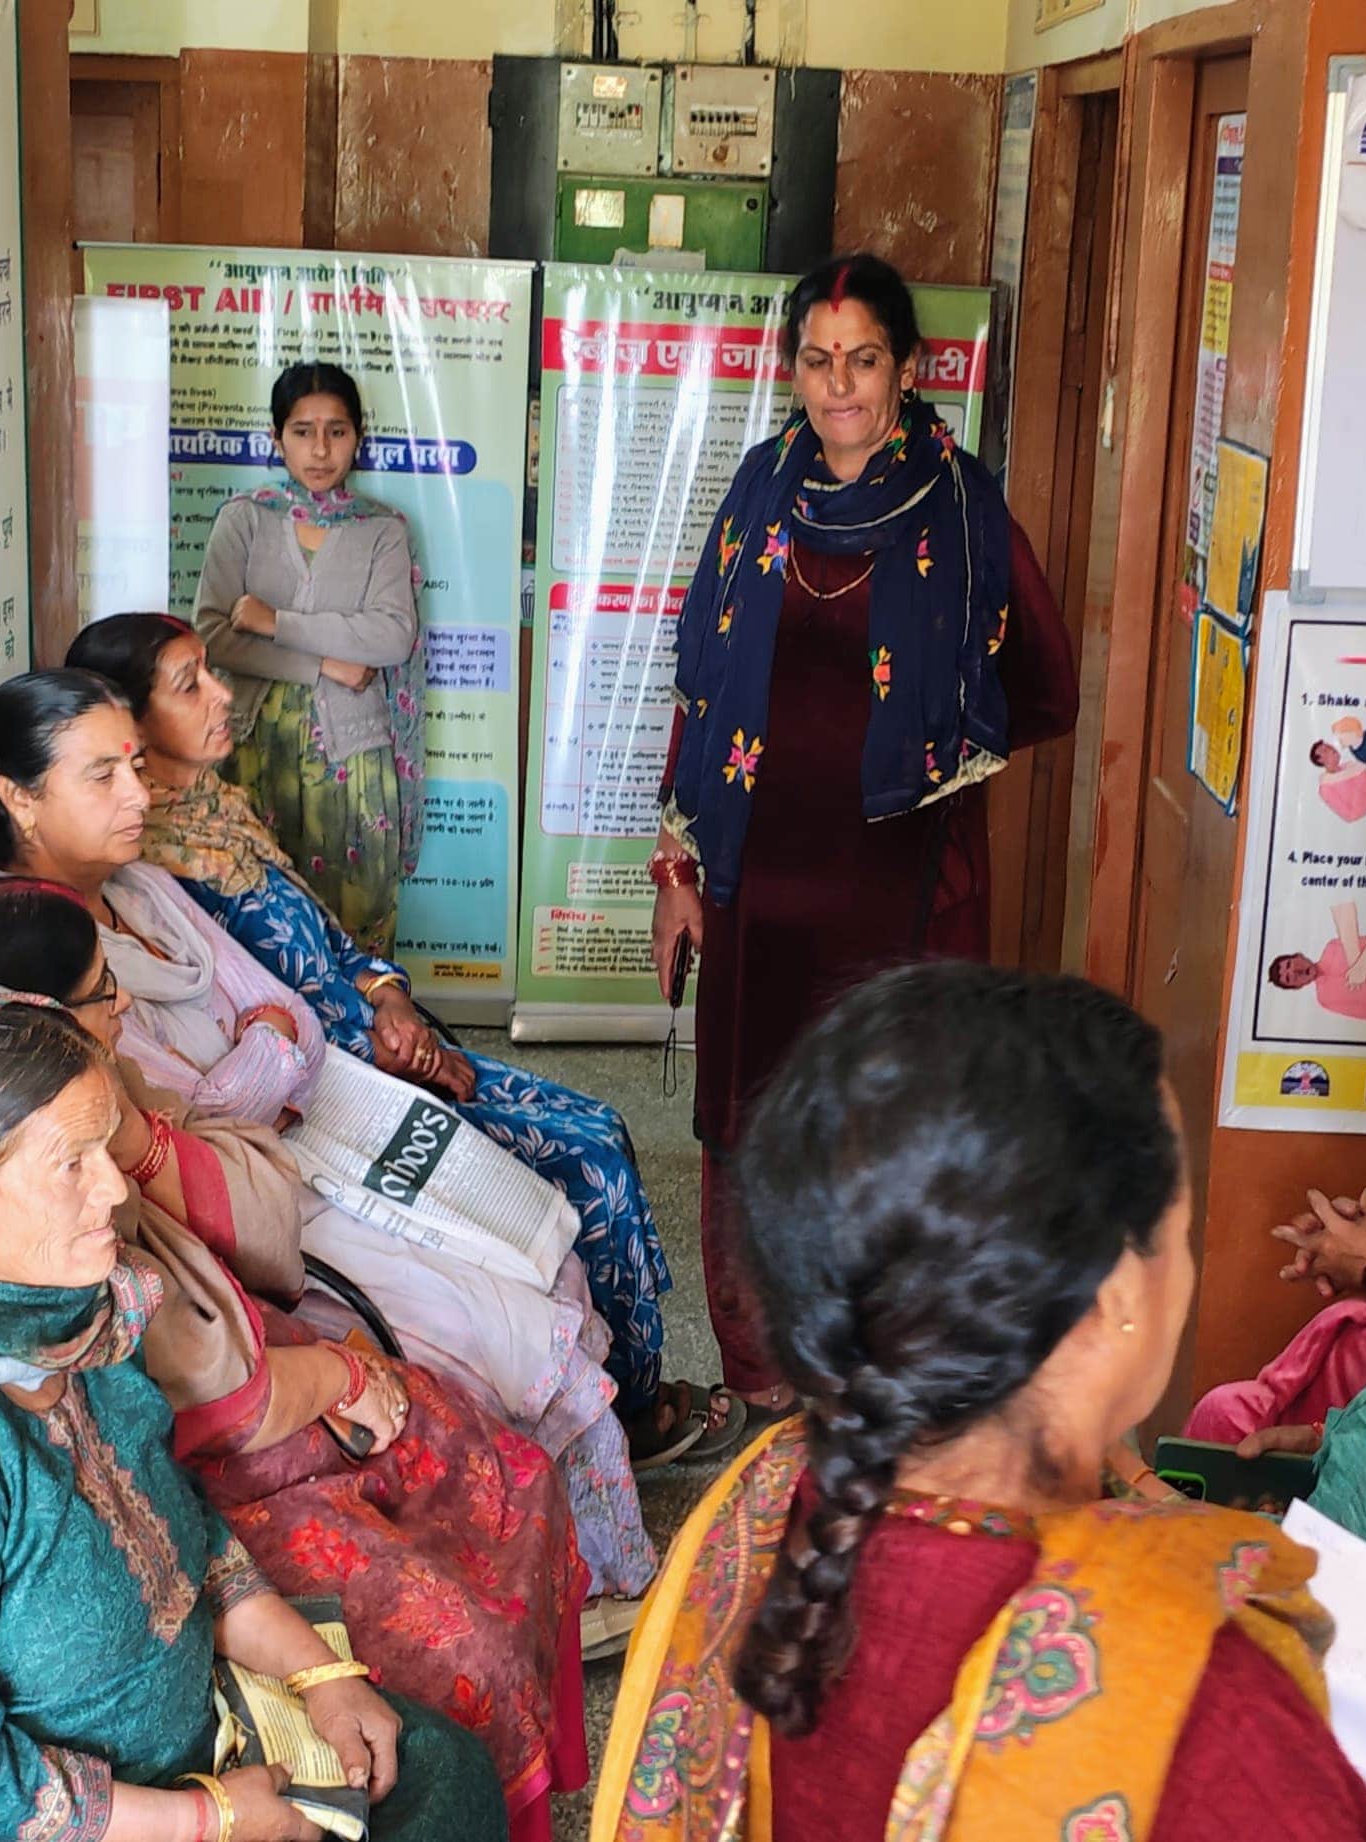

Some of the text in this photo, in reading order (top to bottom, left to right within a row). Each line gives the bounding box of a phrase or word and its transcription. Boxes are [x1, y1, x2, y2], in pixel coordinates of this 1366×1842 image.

[215, 287, 273, 314] AI
[1317, 693, 1360, 707] Shake
[1287, 851, 1298, 864] 4.
[1302, 851, 1334, 865] Place
[1337, 854, 1363, 868] your
[1301, 875, 1339, 887] center
[1341, 875, 1355, 888] of
